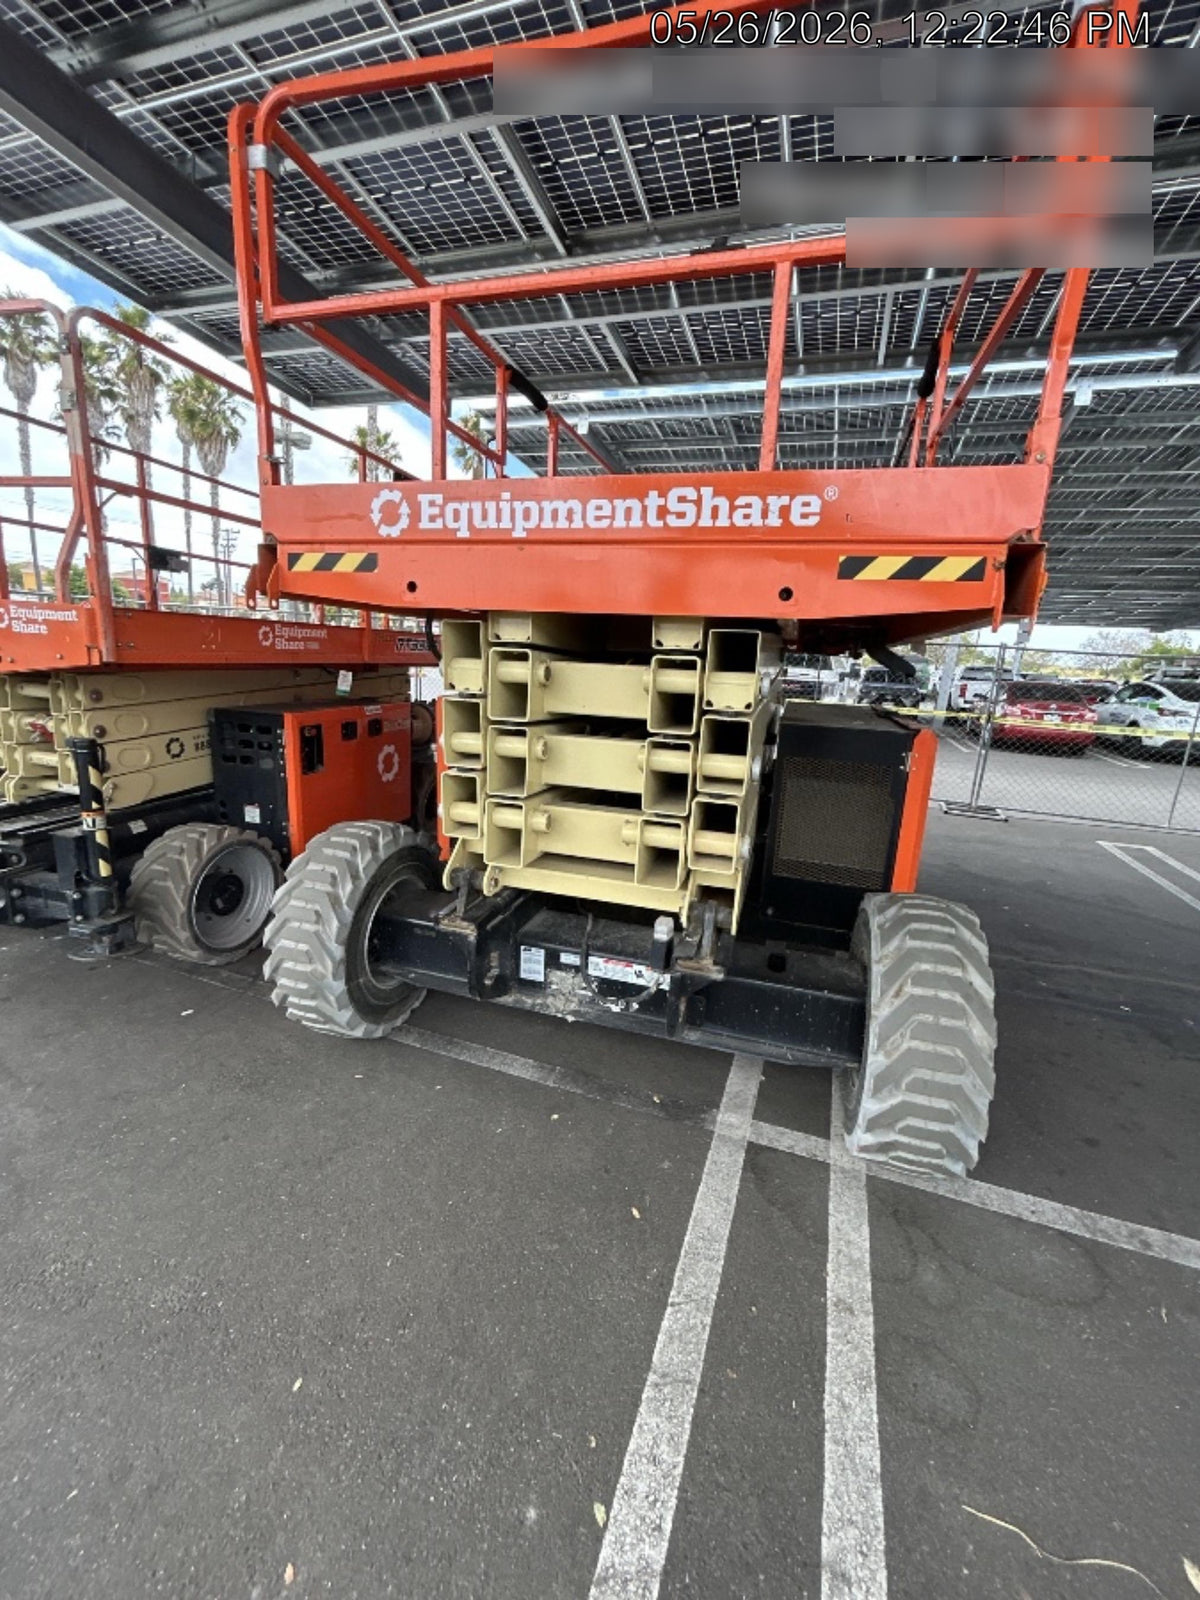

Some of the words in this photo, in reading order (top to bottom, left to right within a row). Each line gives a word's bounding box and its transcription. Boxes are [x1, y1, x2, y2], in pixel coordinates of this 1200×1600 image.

[9, 605, 78, 622] Equipment
[12, 620, 48, 634] Share
[275, 624, 327, 639] Equipment
[275, 638, 304, 649] Share
